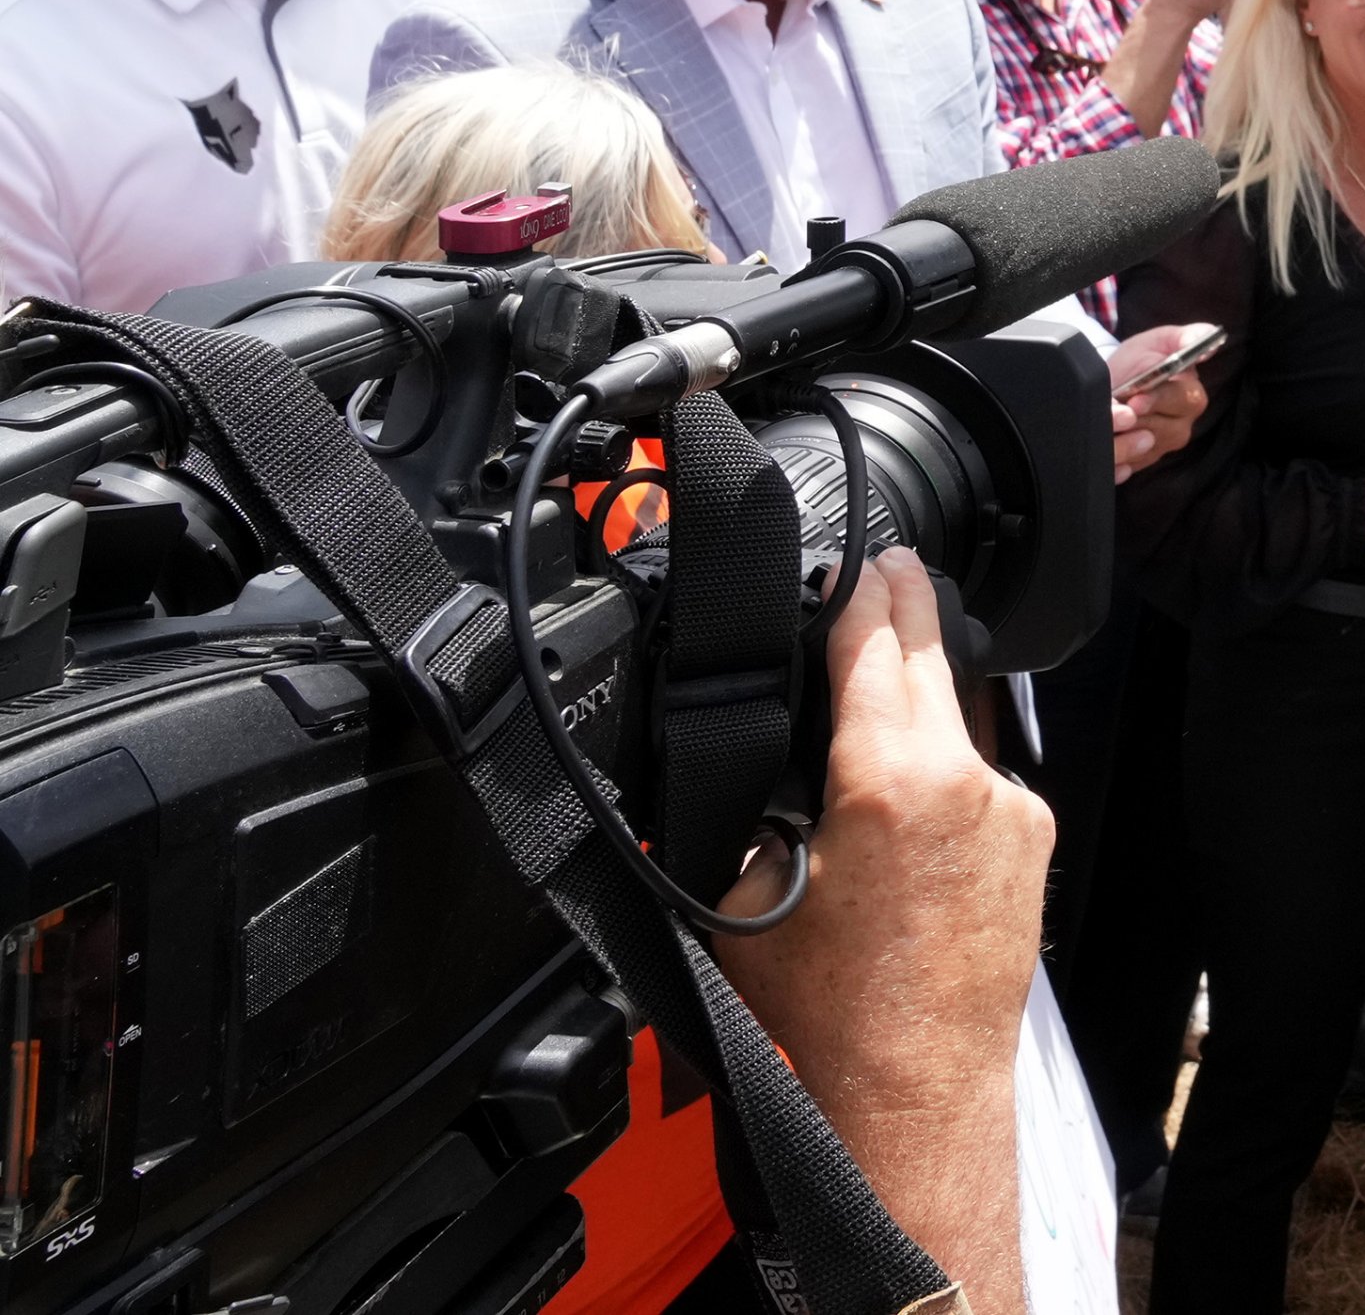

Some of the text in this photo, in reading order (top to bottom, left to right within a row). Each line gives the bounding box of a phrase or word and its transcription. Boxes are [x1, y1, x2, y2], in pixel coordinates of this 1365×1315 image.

[559, 673, 617, 734] ONY
[127, 952, 140, 966] SD
[118, 1030, 142, 1048] OPEN
